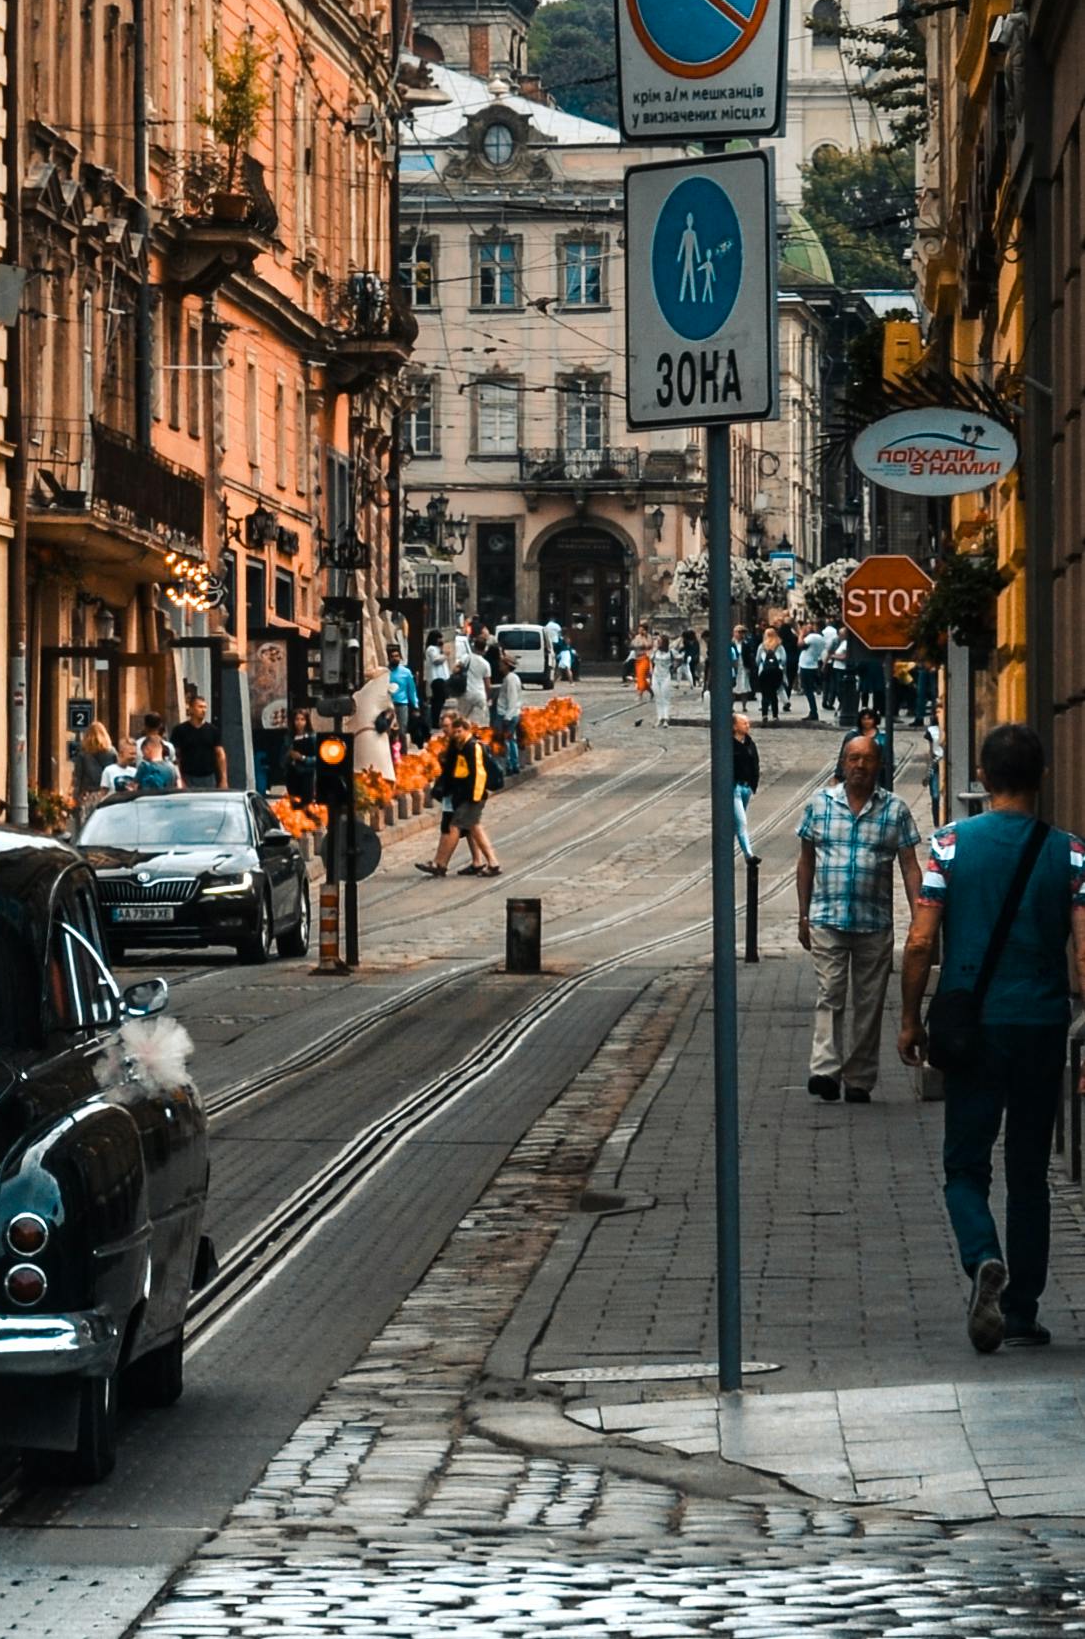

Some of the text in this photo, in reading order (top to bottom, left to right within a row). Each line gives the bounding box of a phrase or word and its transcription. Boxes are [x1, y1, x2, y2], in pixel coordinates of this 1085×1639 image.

[633, 83, 764, 107] крім а/м мешканців
[632, 106, 766, 129] у визначених місцях
[656, 349, 742, 408] ЗОНА
[877, 447, 976, 463] ПОЇХАЛИ
[929, 461, 1001, 475] НАМИ!
[76, 713, 85, 725] 2
